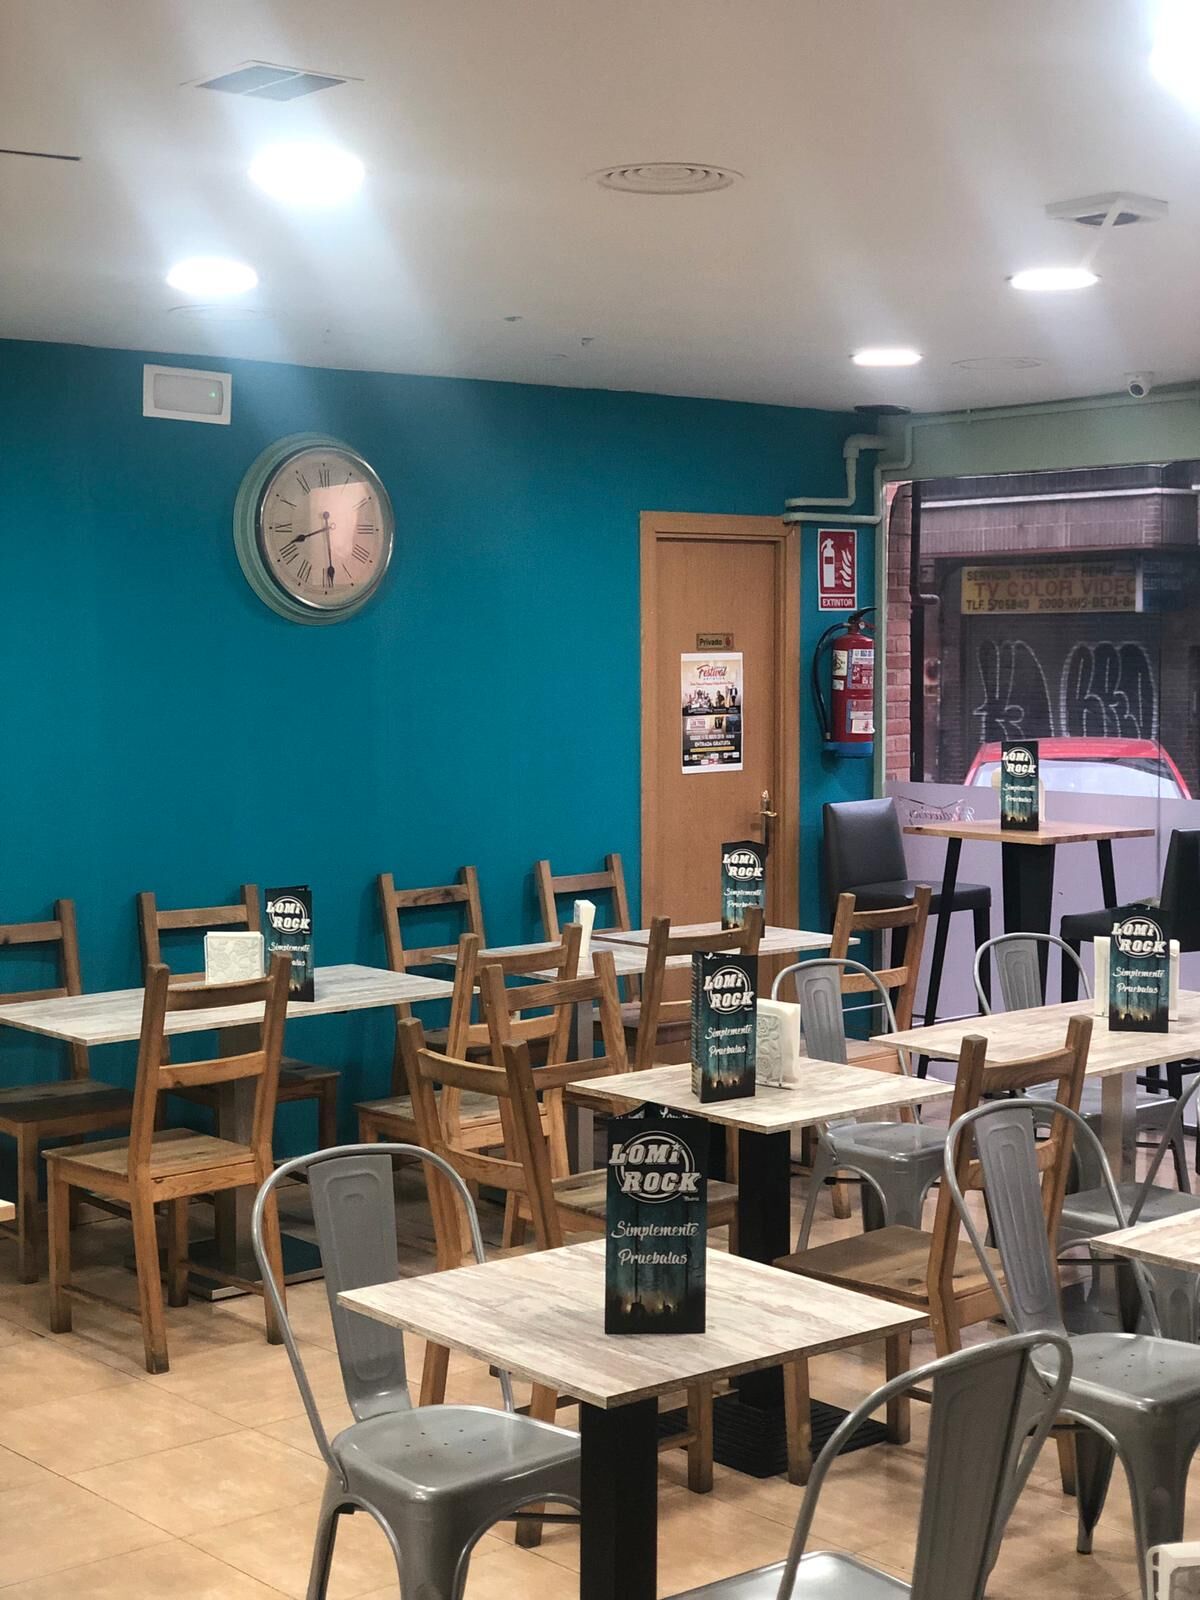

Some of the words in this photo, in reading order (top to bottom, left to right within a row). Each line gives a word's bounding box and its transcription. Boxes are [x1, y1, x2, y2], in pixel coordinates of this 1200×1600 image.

[974, 582, 1000, 598] TV
[1008, 580, 1073, 597] COLOR
[822, 598, 853, 606] EXTINTOR
[699, 638, 723, 646] Privado
[697, 664, 727, 678] Festival
[1007, 764, 1037, 773] ROCK
[728, 867, 764, 877] ROCK
[273, 917, 311, 929] ROCK
[268, 942, 310, 952] Simplemente
[1119, 939, 1167, 953] ROCK
[1113, 967, 1165, 979] Simplemente
[710, 991, 754, 1009] ROCK
[705, 1024, 753, 1040] Simplemente
[709, 1045, 746, 1057] Pruebalas
[621, 1171, 702, 1194] ROCK
[611, 1220, 699, 1241] Simplemente
[618, 1248, 688, 1266] Pruebalas
